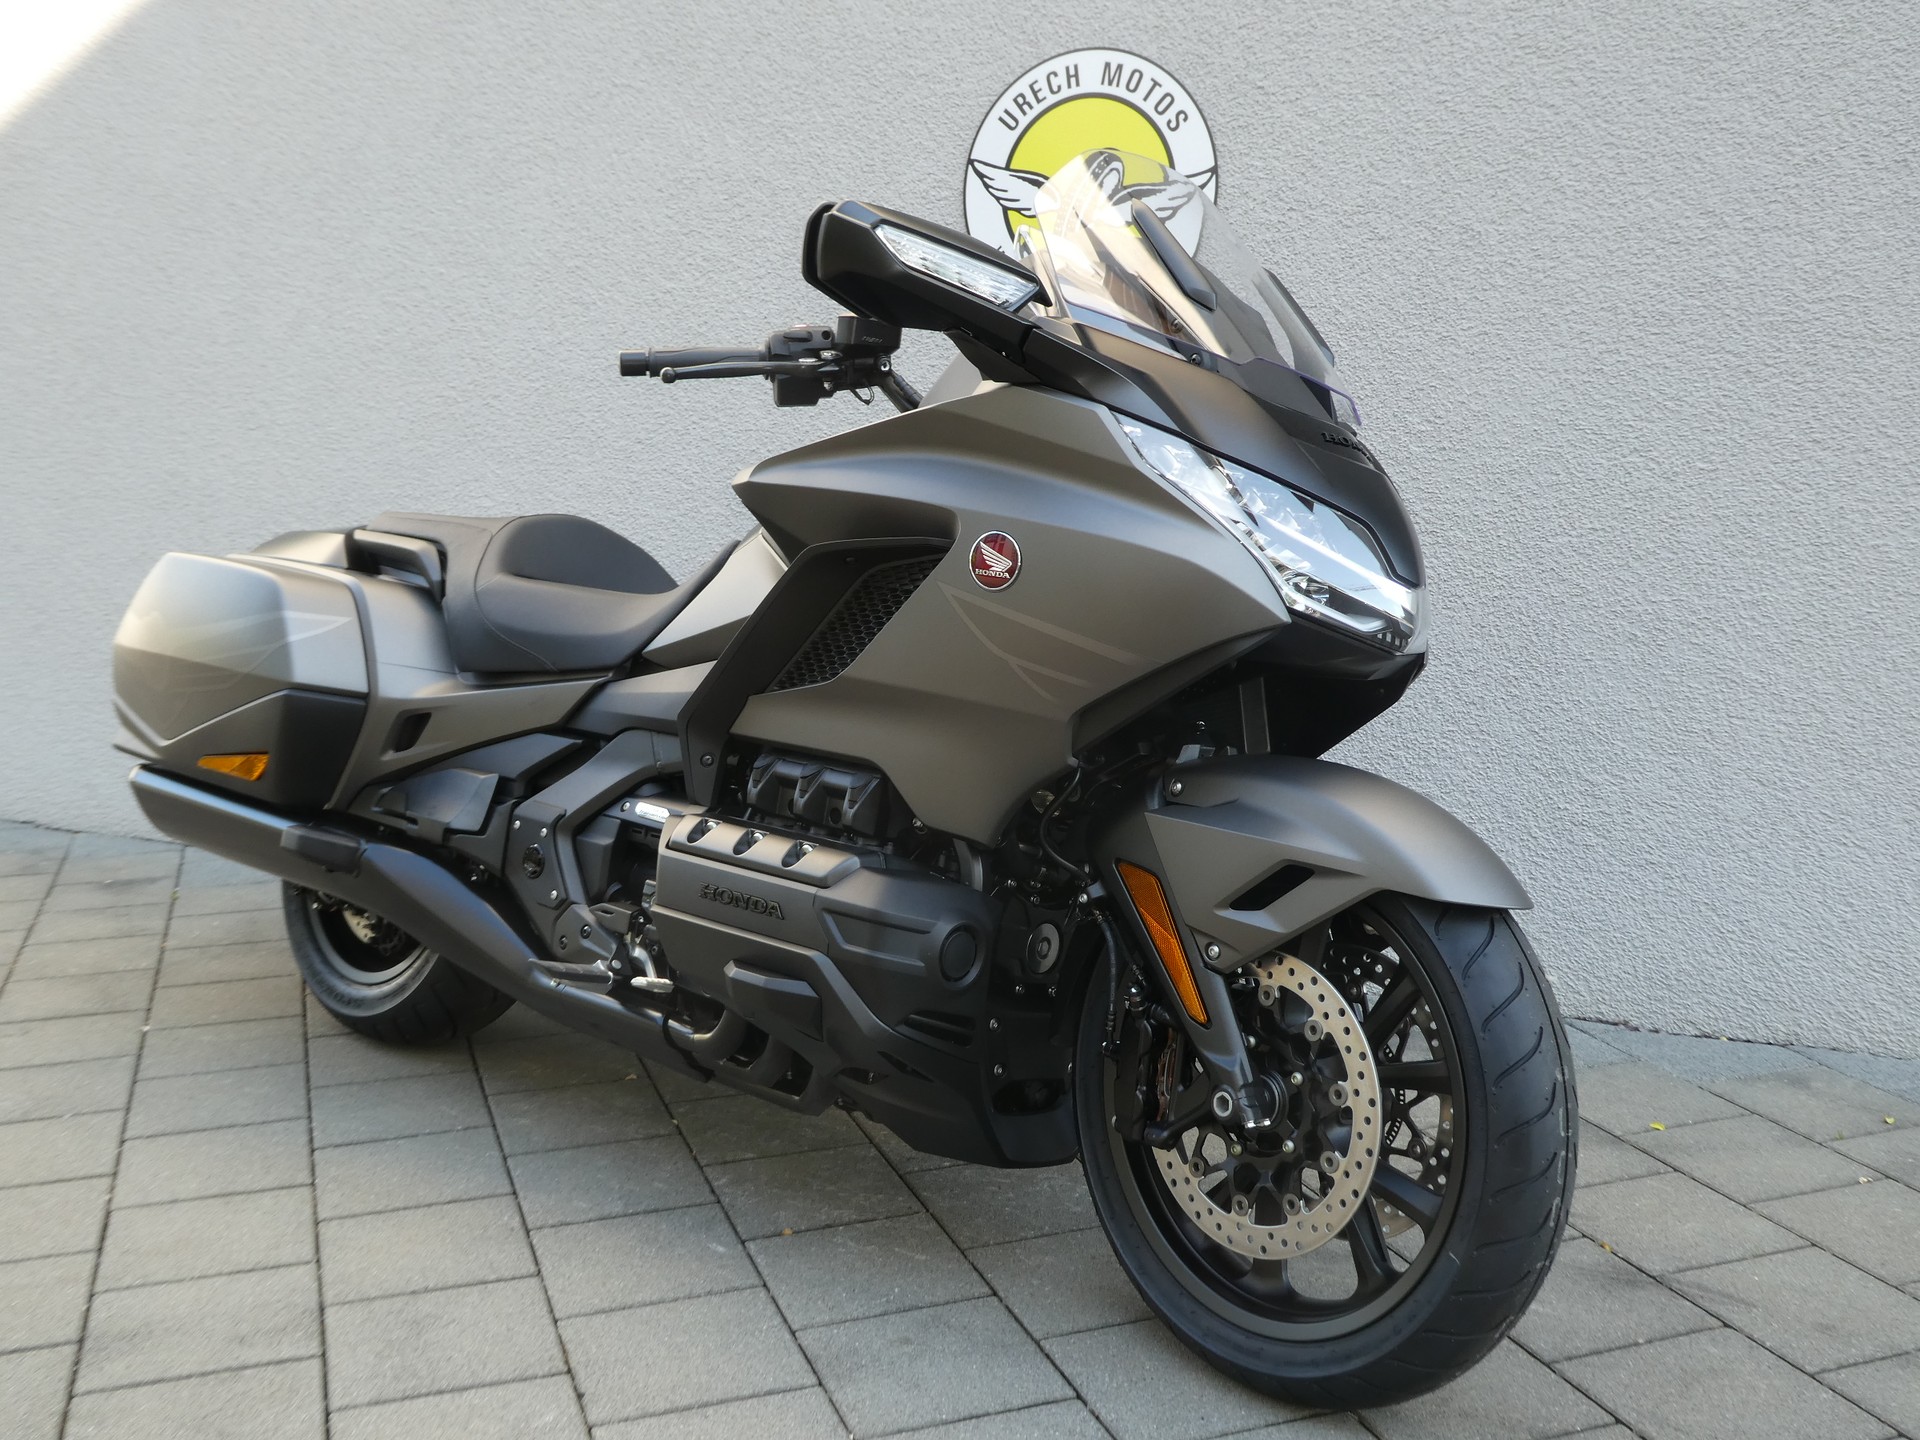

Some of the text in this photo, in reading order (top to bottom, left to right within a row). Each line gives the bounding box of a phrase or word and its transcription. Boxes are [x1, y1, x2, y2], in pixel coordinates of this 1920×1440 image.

[997, 61, 1189, 132] URECH MOTOS
[975, 568, 1011, 579] HONDA
[699, 882, 784, 920] HONDA
